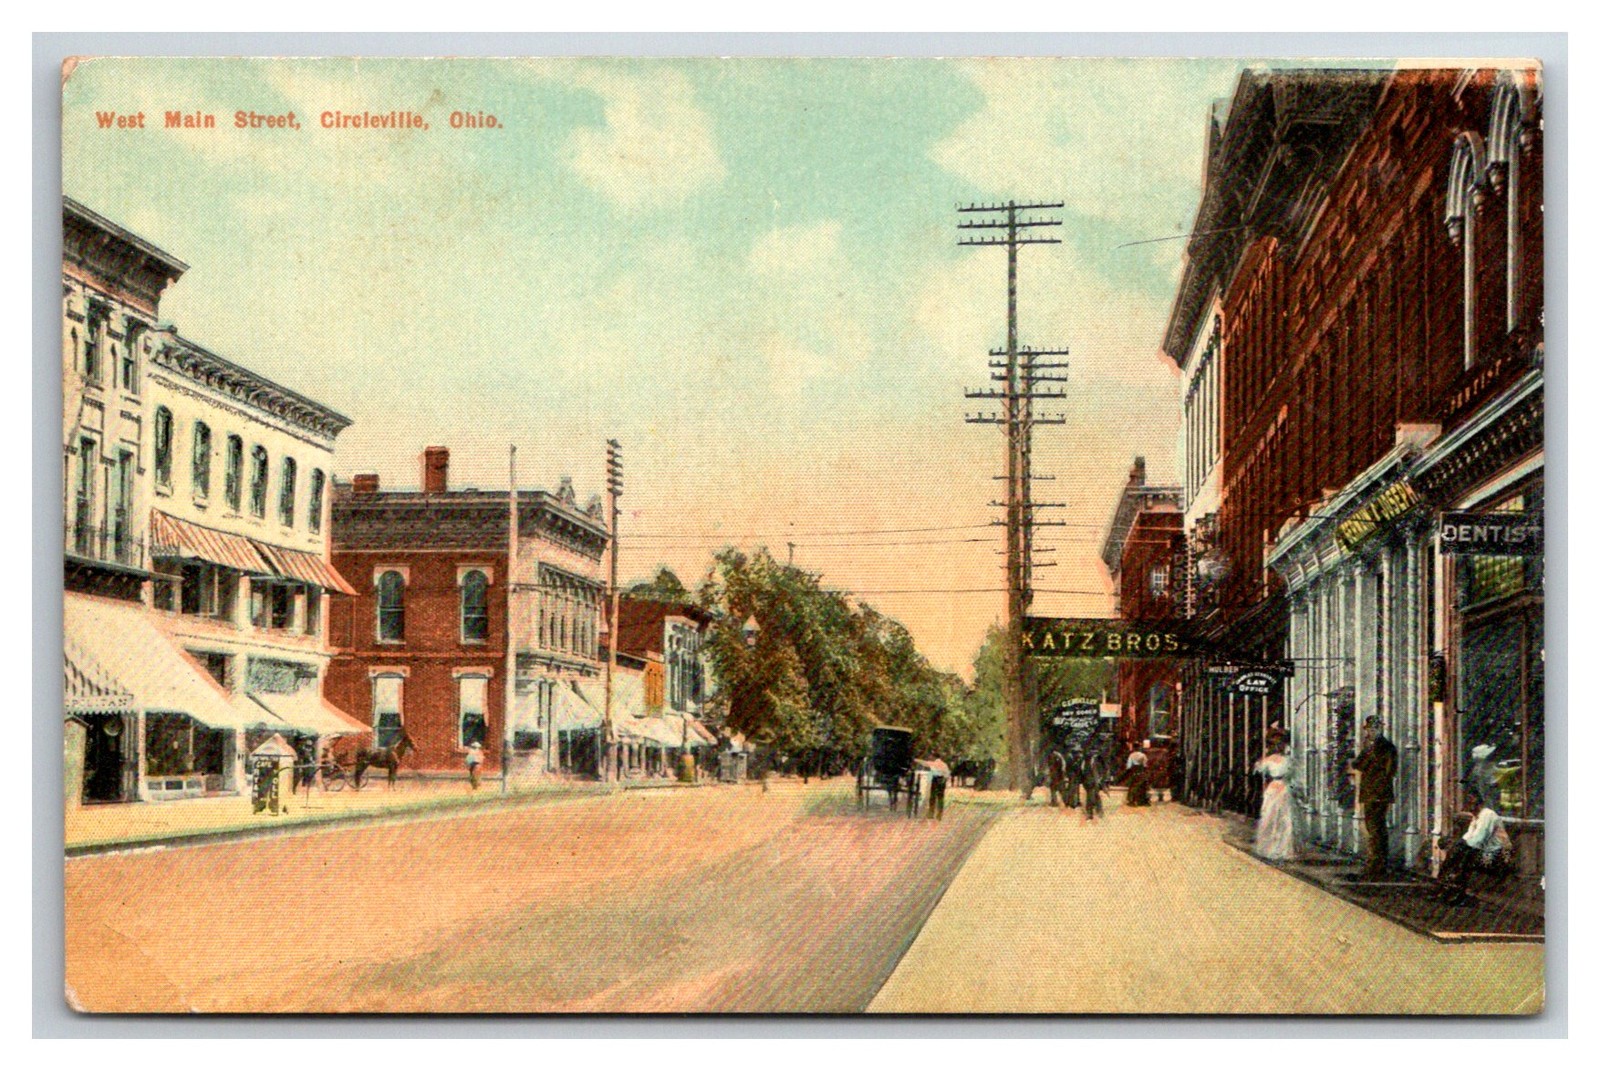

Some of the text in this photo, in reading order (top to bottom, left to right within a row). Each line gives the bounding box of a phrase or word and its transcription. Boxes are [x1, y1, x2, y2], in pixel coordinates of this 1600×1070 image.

[1441, 524, 1542, 542] DENTIST
[1021, 632, 1095, 649] KATZ
[1238, 684, 1269, 692] OFFICE
